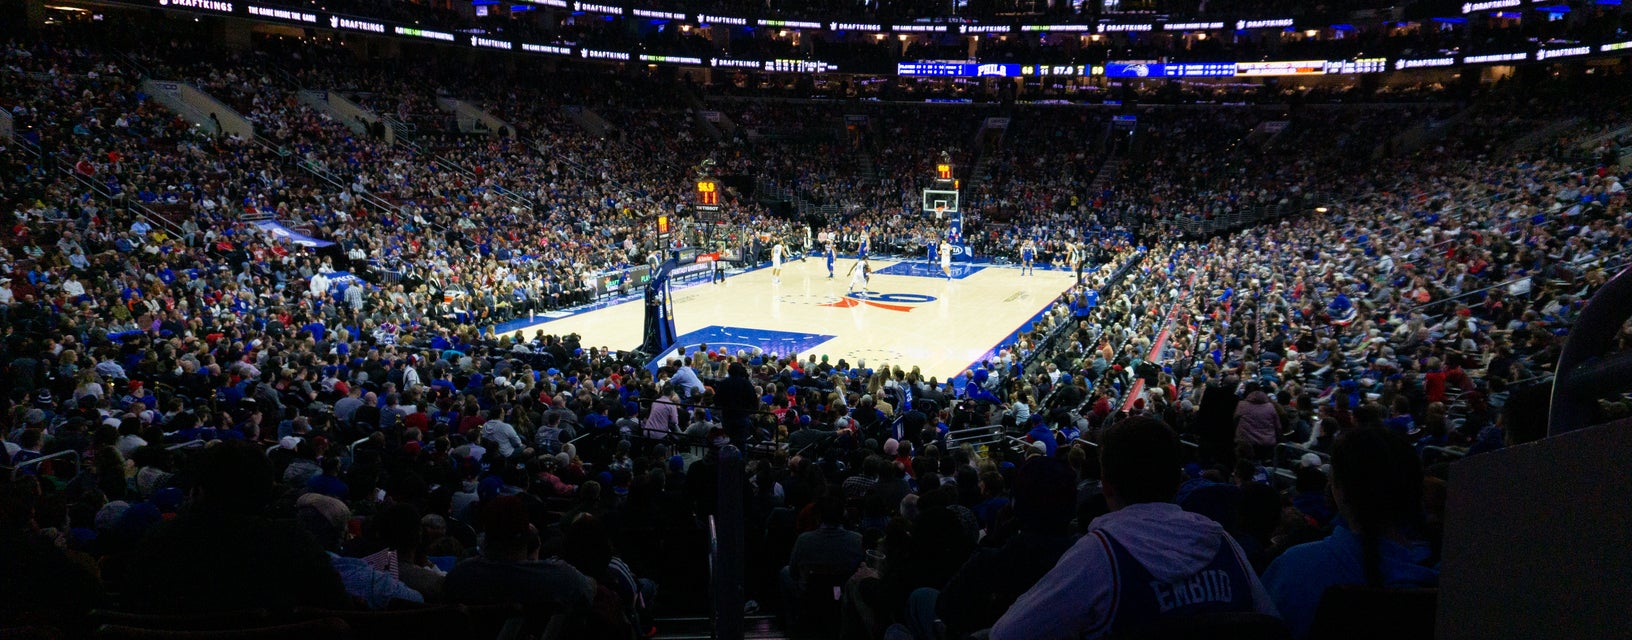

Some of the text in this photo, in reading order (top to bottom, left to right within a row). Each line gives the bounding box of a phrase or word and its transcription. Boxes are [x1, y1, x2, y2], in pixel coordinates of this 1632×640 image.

[582, 3, 623, 15] DRAFTKINGS
[340, 18, 384, 33] DRAFTKINGS
[706, 16, 747, 25] DRAFTKINGS
[1246, 18, 1293, 28] DRAFTKINGS
[839, 23, 881, 31] DRAFTKINGS
[1106, 24, 1152, 32] DRAFTKINGS
[478, 37, 512, 50] DRAFTKINGS
[590, 50, 630, 61] DRAFTKINGS
[1545, 46, 1590, 58] DRAFTKINGS
[719, 59, 760, 68] DRAFTKINGS
[1405, 57, 1454, 68] DRAFTKINGS
[977, 64, 1006, 77] PHILA
[704, 192, 717, 204] 11
